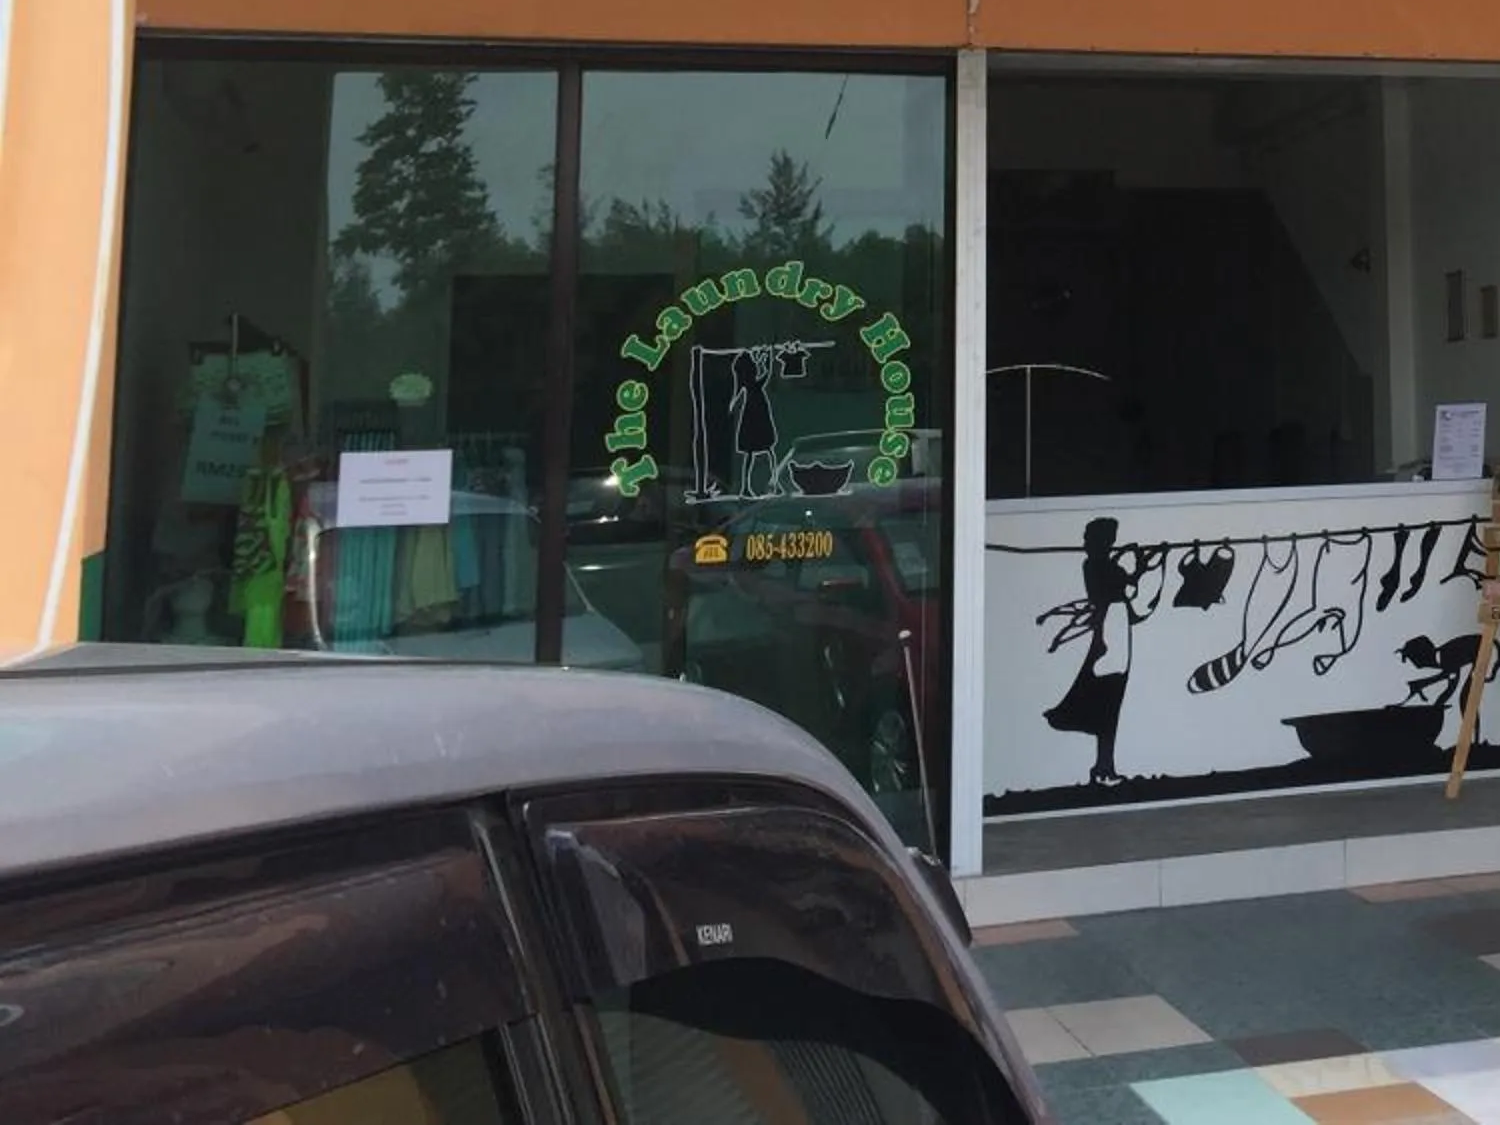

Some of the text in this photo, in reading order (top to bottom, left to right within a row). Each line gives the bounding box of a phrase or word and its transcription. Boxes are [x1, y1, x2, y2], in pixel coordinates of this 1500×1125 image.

[605, 260, 915, 498] The Laundry House
[745, 530, 834, 561] 085-433200
